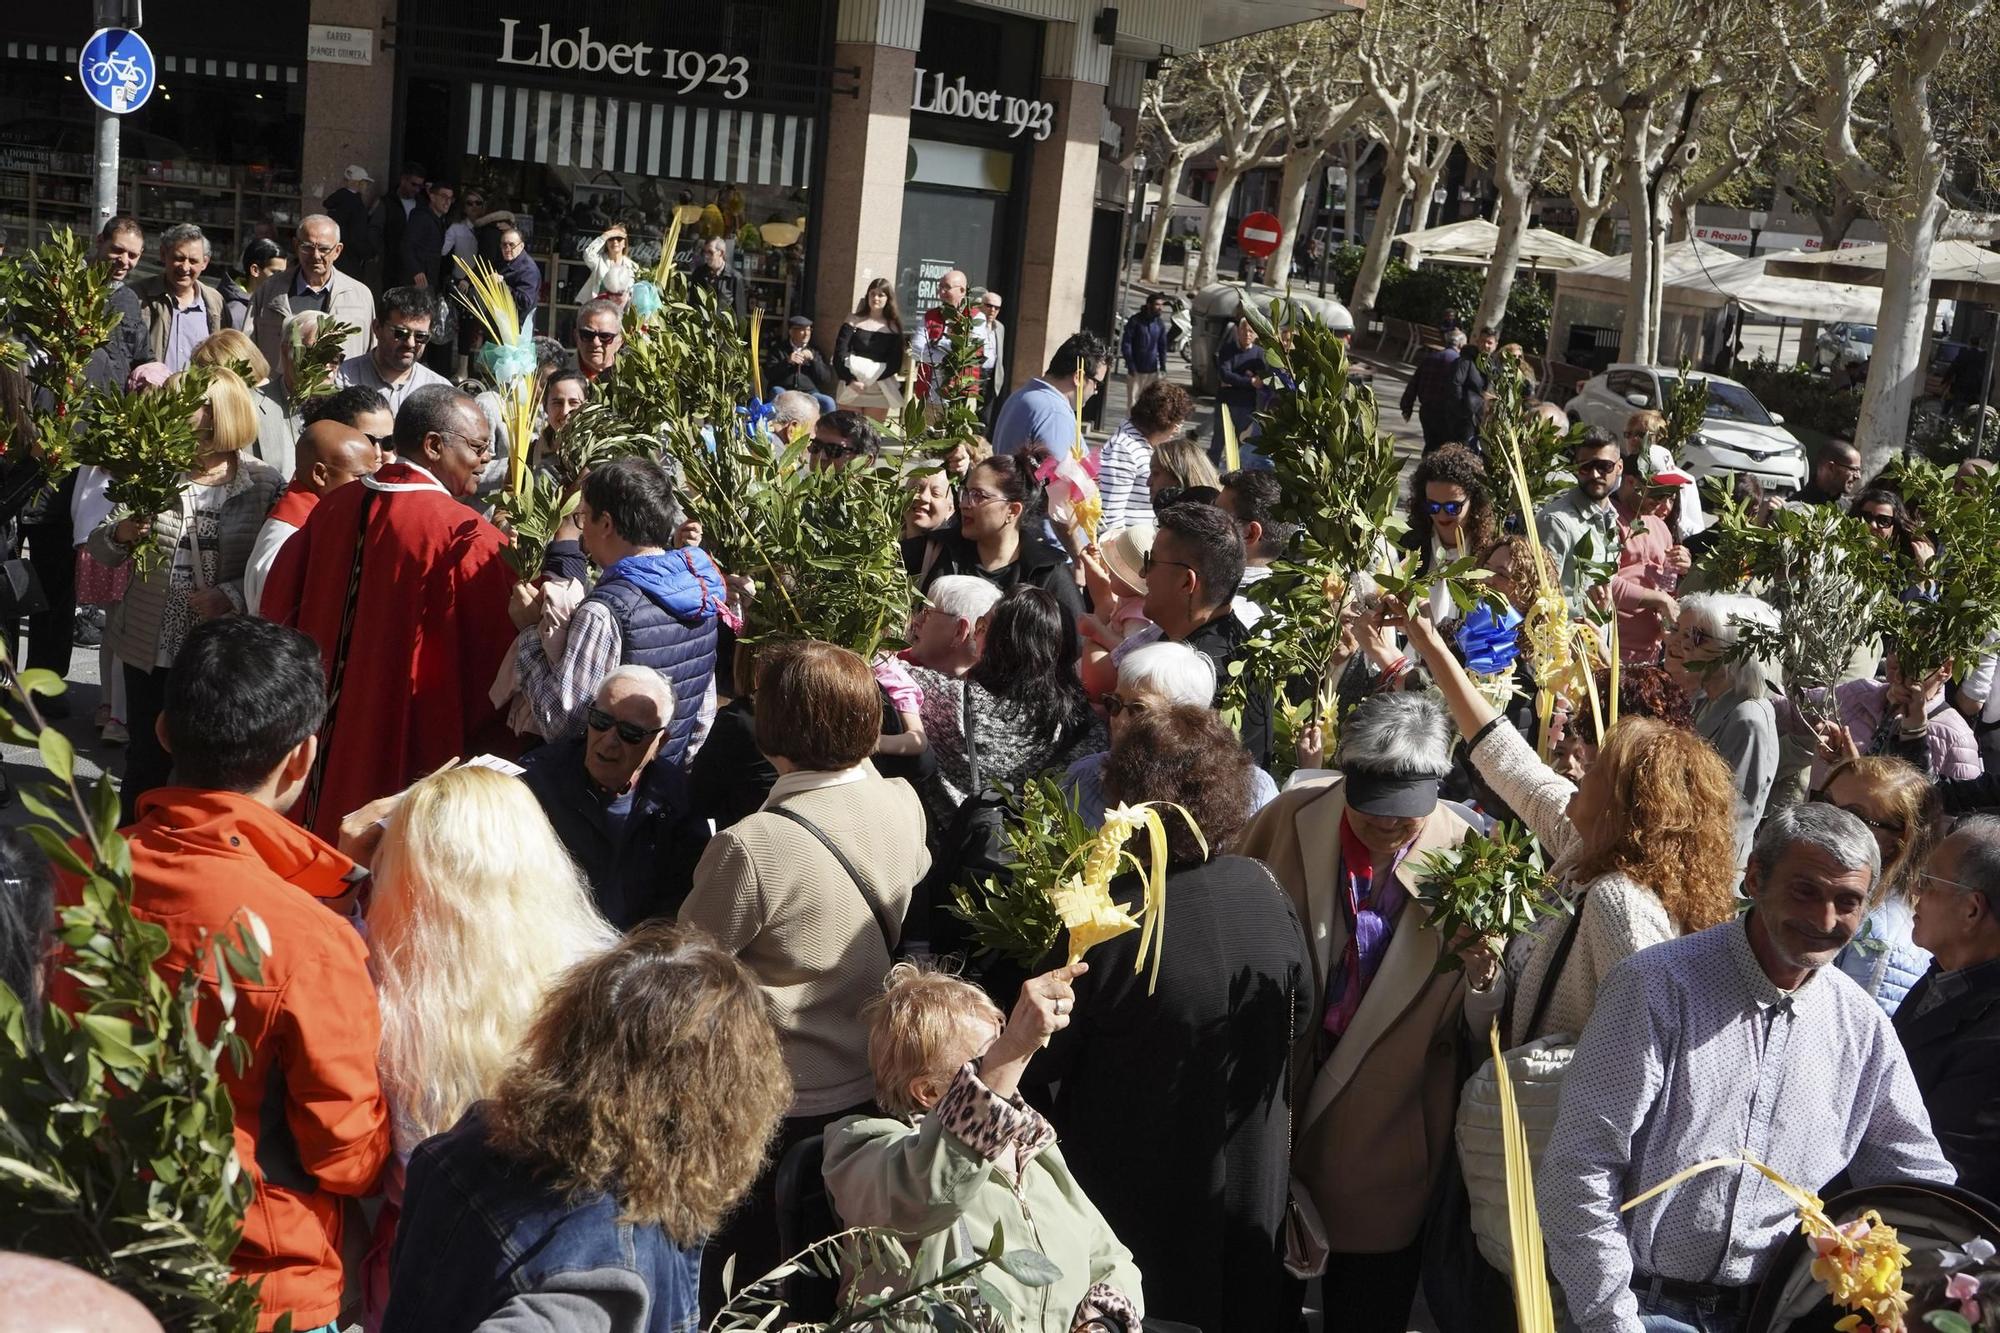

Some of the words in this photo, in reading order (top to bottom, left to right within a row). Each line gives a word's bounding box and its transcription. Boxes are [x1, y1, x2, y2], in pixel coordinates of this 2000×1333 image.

[327, 31, 352, 41] CARRER
[497, 18, 653, 76] Llobet
[662, 48, 749, 99] 1923
[911, 68, 1002, 122] Llobet
[1002, 96, 1054, 141] 1923
[1696, 229, 1707, 238] El
[1711, 230, 1748, 242] Regalo
